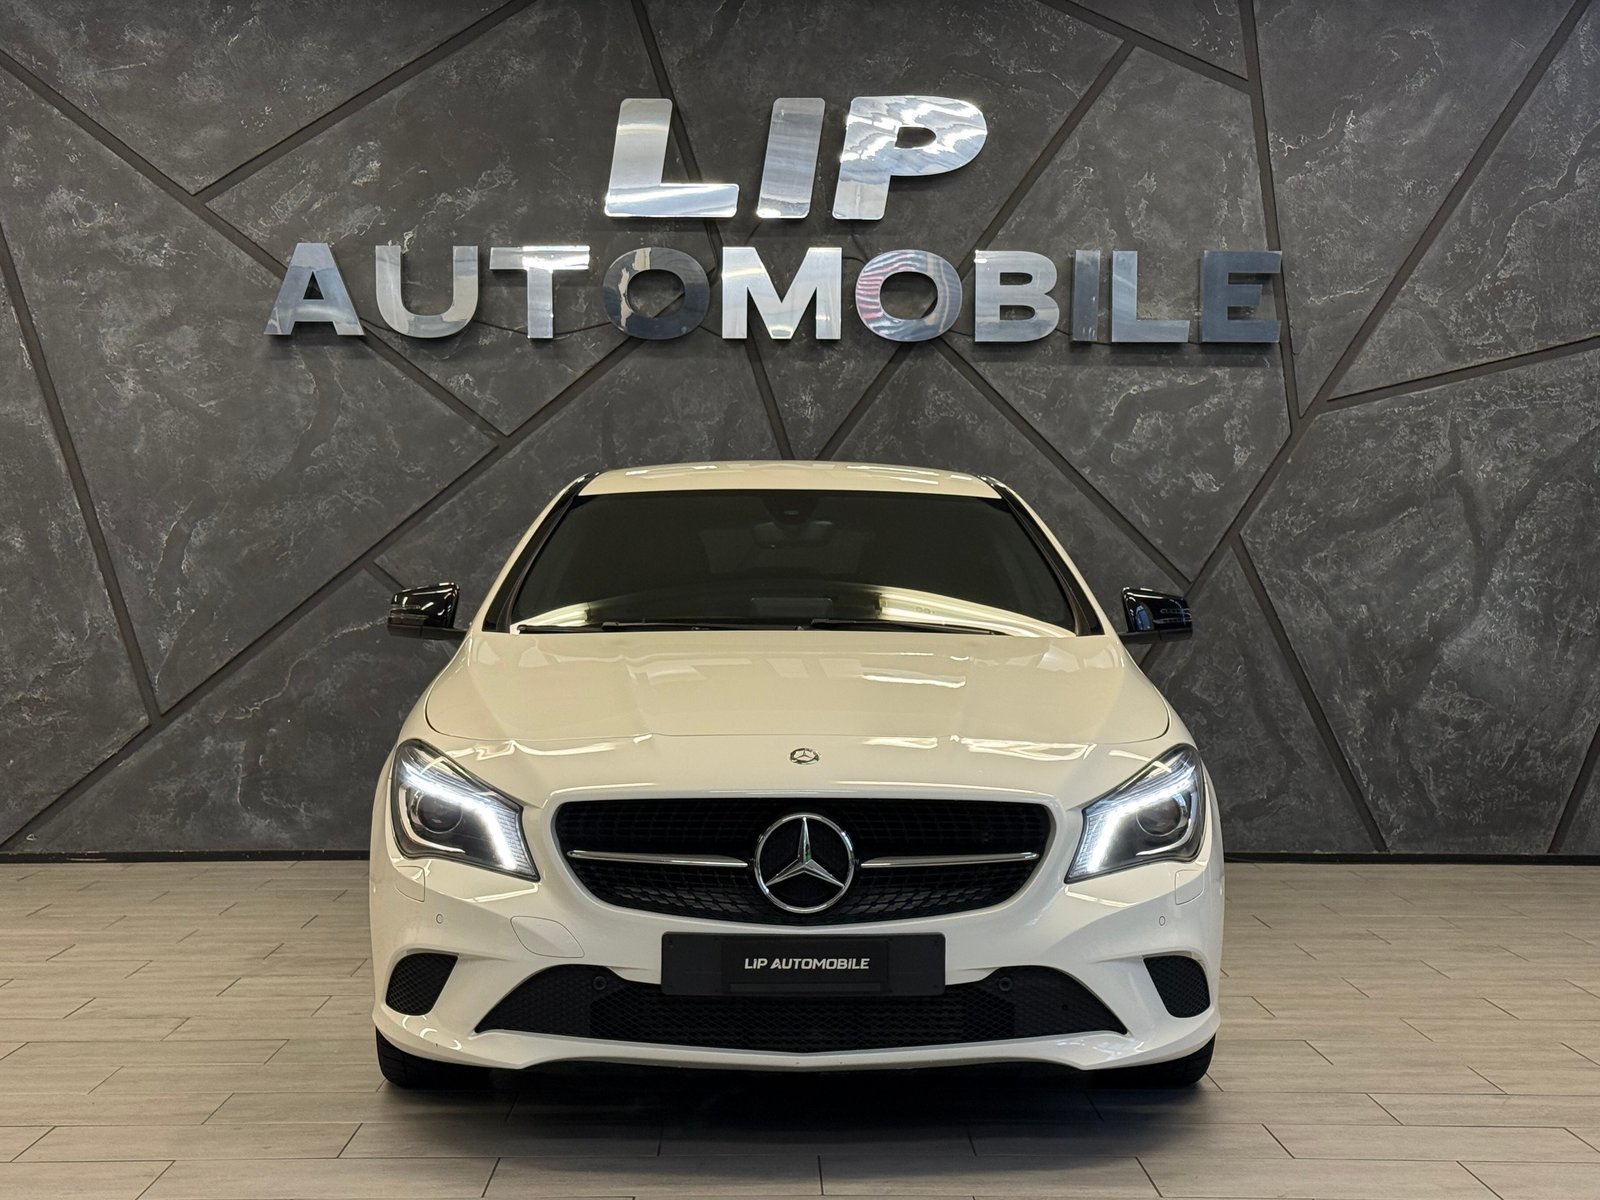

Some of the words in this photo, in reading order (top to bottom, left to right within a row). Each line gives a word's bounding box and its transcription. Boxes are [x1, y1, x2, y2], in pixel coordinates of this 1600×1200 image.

[604, 96, 988, 220] LIP
[265, 242, 1282, 344] AUTOMOBILE
[744, 957, 768, 970] LIP
[770, 957, 870, 970] AUTOMOBILE
